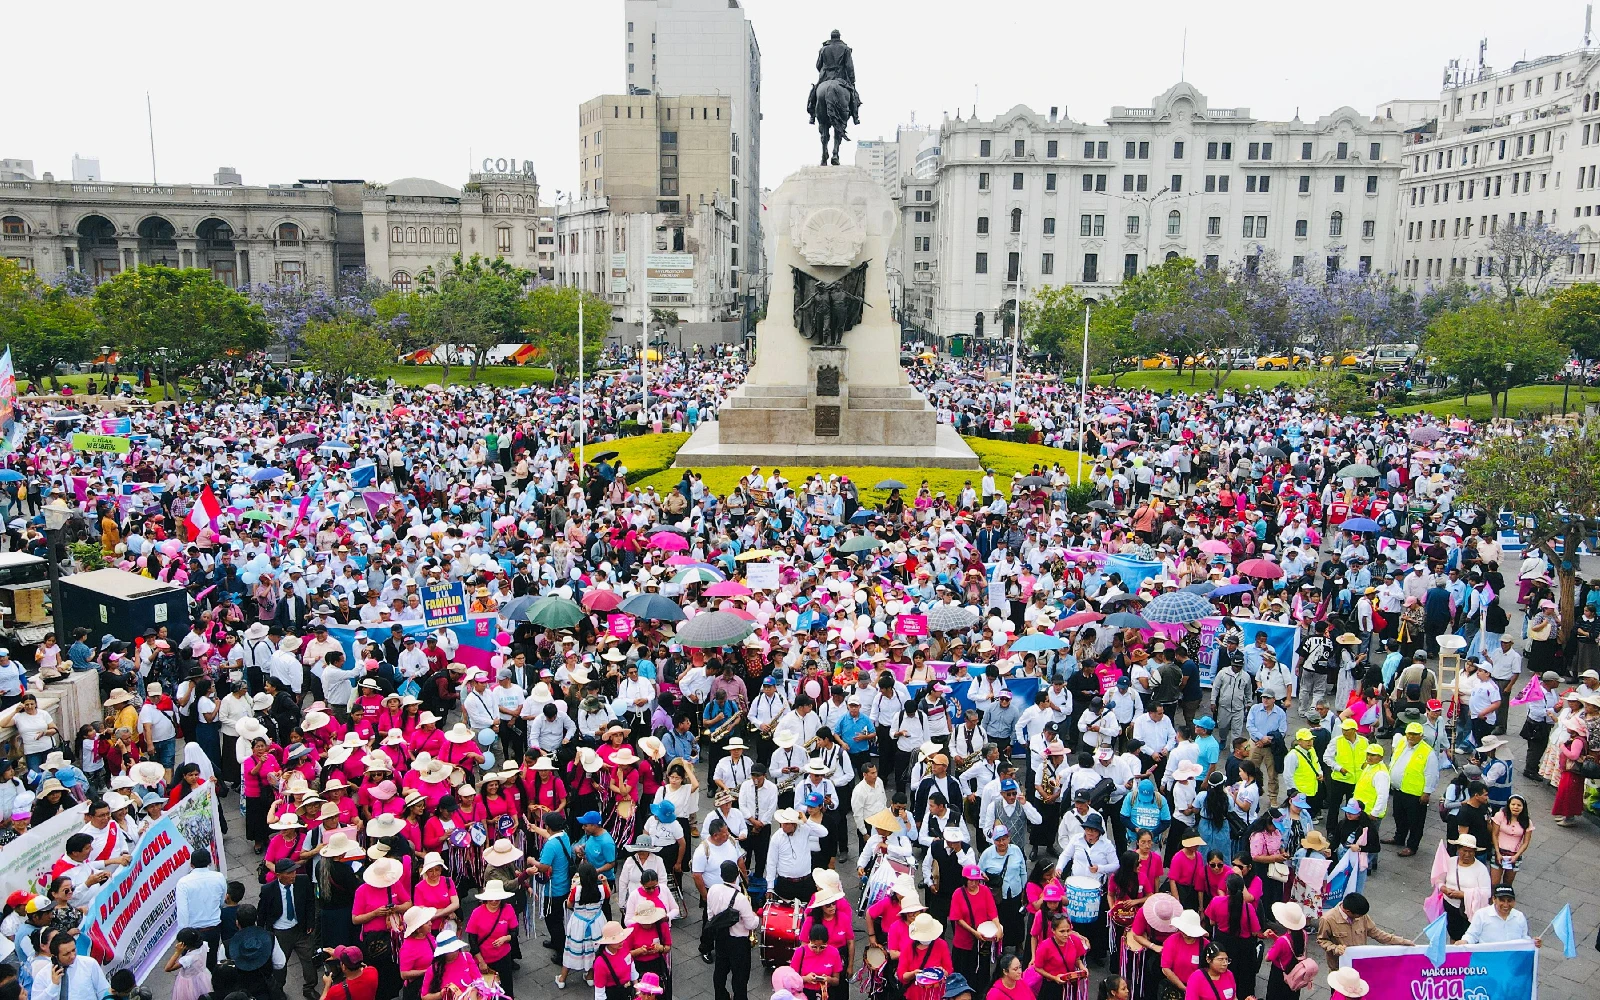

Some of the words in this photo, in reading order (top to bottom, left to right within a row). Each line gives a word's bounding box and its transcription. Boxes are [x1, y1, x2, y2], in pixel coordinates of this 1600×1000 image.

[425, 596, 462, 610] FAMILIA
[432, 609, 442, 617] NO
[443, 608, 448, 616] A
[449, 606, 457, 614] LA
[108, 890, 119, 915] LA
[142, 830, 171, 866] CIVIL
[150, 845, 190, 890] CAMUFLADO
[1422, 968, 1457, 976] MARCHA
[1459, 967, 1475, 975] POR
[1476, 966, 1487, 975] LA
[1411, 977, 1464, 1000] Vida
